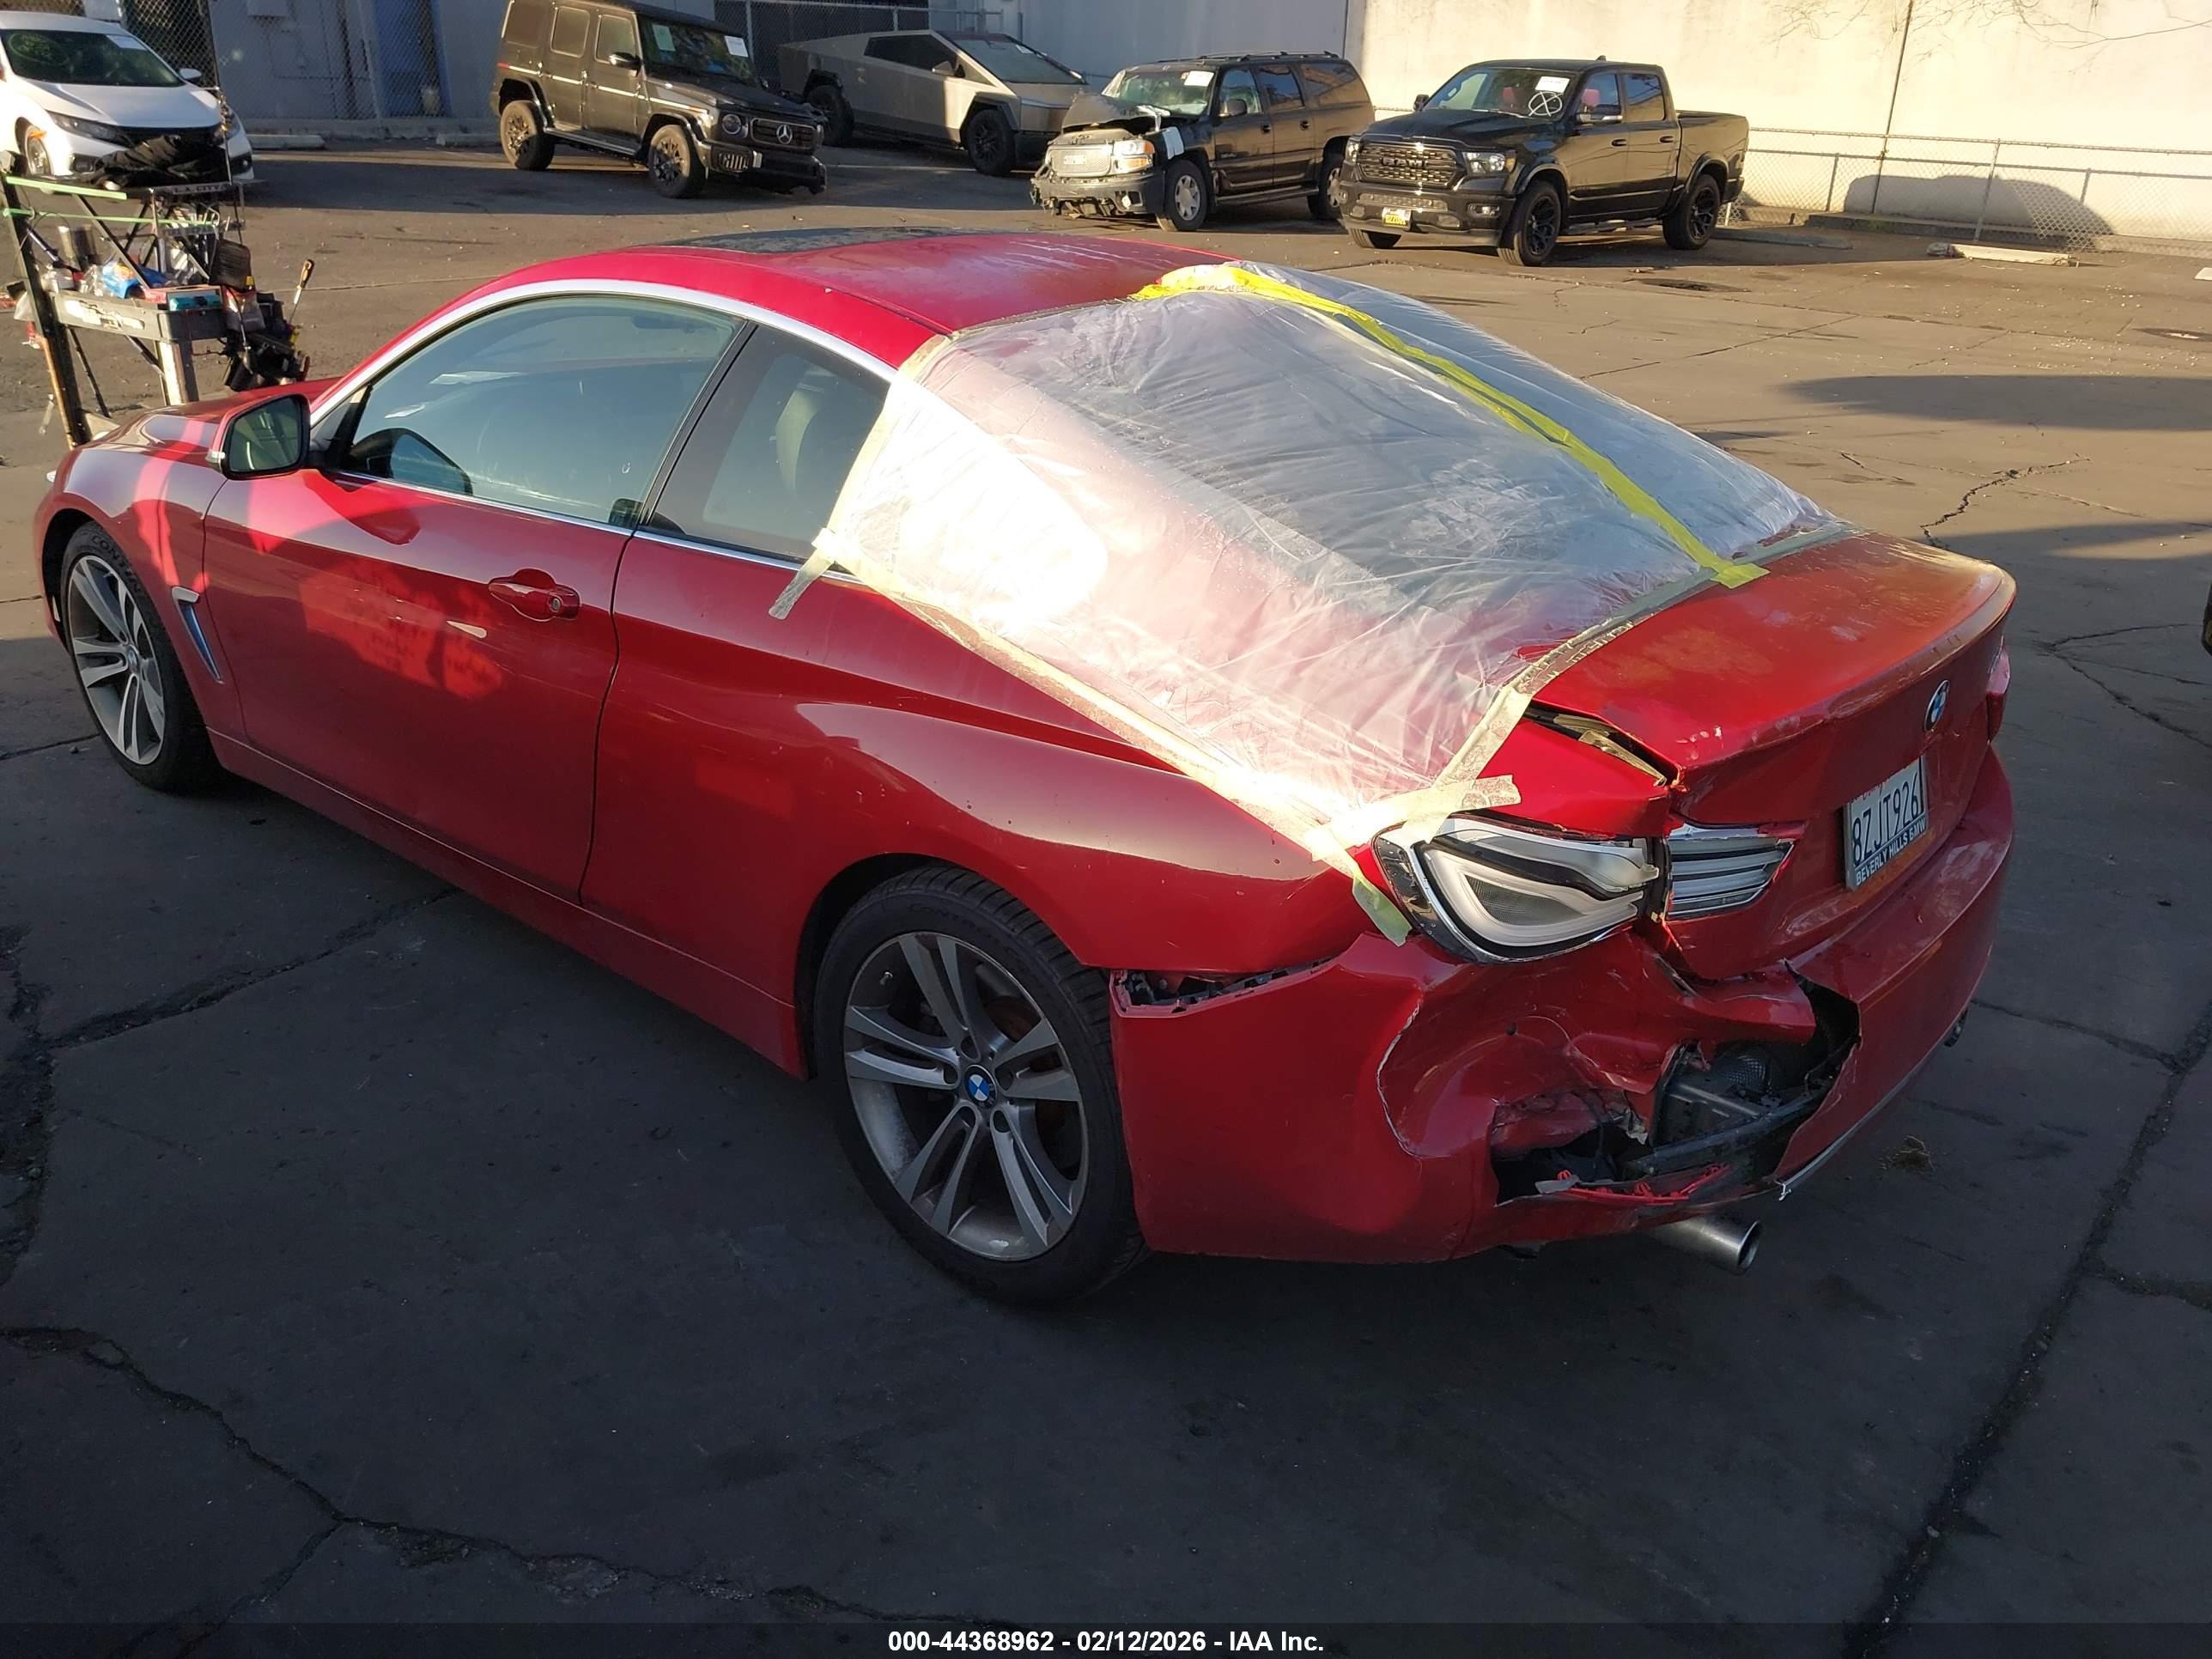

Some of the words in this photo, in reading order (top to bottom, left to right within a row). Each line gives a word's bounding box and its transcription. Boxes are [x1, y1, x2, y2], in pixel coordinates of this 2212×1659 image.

[1852, 772, 1919, 866] 8ZJT926
[1856, 848, 1889, 886] BEVERLY
[1888, 833, 1908, 859] HILLS
[1909, 817, 1926, 840] BMW
